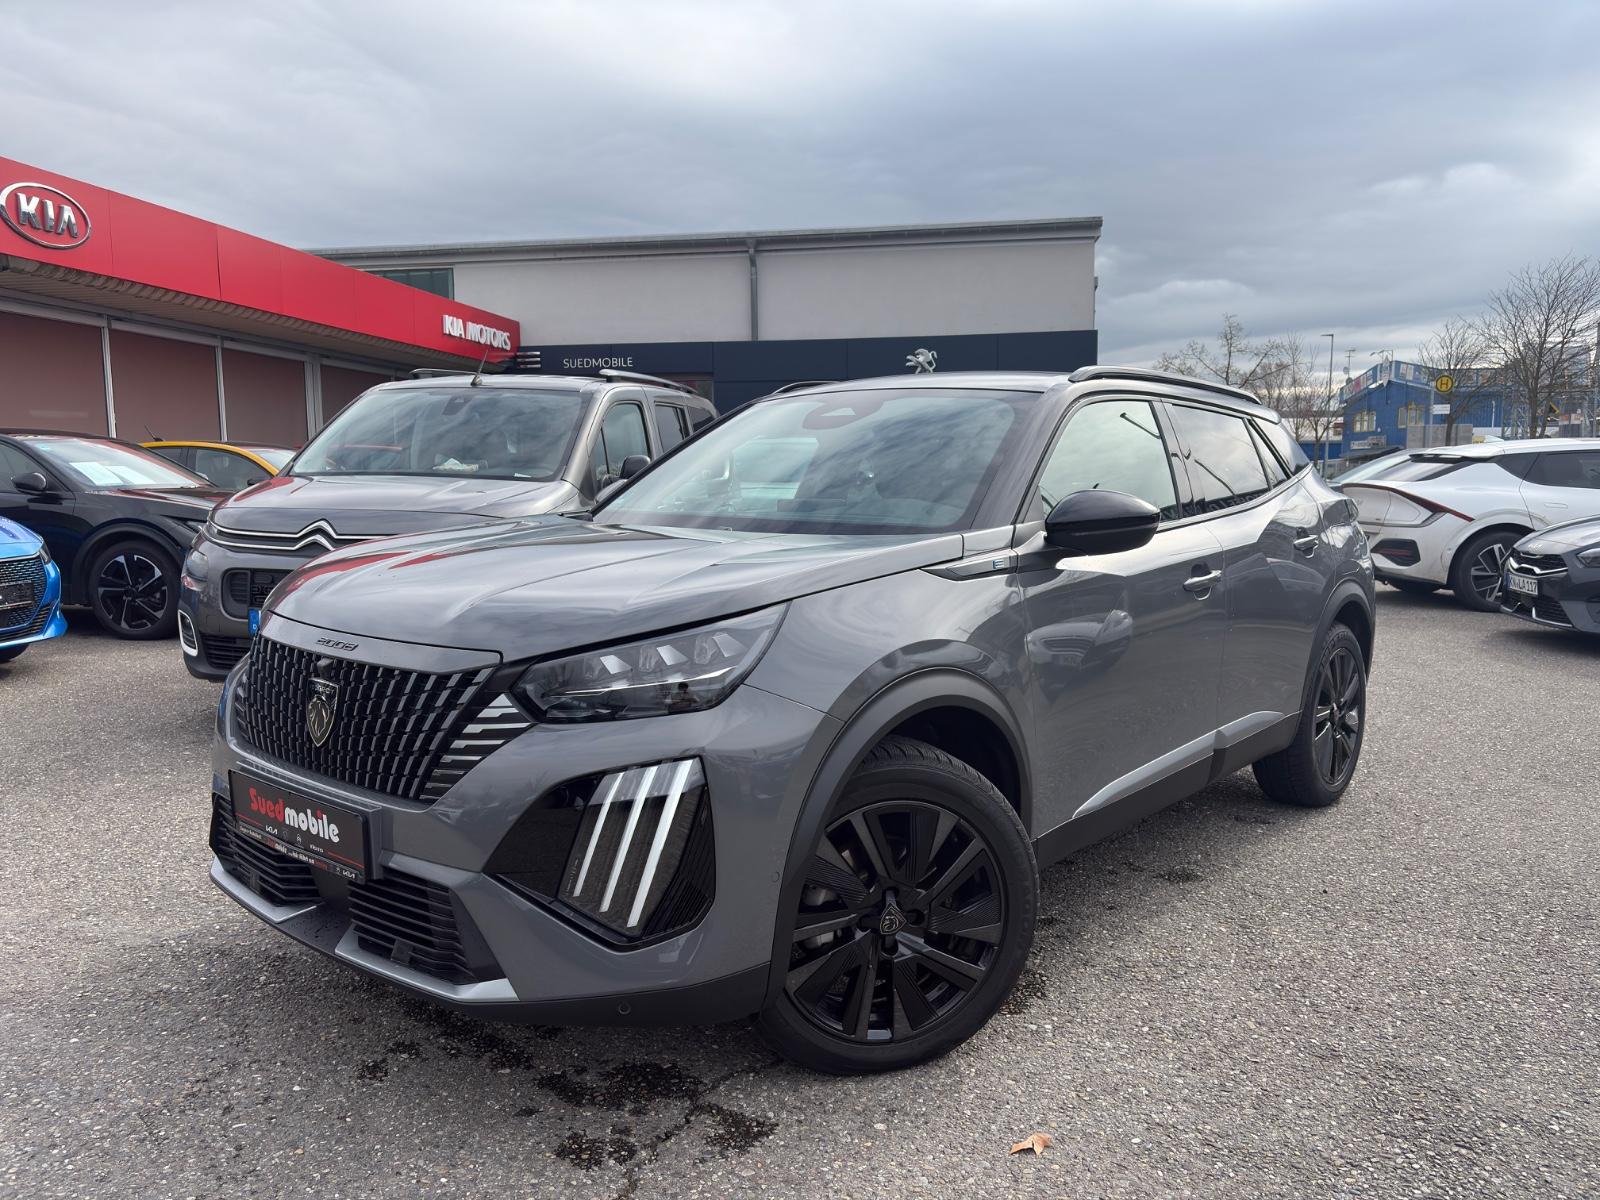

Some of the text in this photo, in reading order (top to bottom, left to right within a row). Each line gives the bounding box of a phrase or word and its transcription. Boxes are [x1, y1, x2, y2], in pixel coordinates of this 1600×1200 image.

[16, 192, 79, 238] KIA
[443, 314, 511, 351] KIA MOTORS
[563, 357, 633, 369] SUEDMOBILE
[316, 637, 359, 652] 2008
[249, 787, 340, 843] Suedmobile
